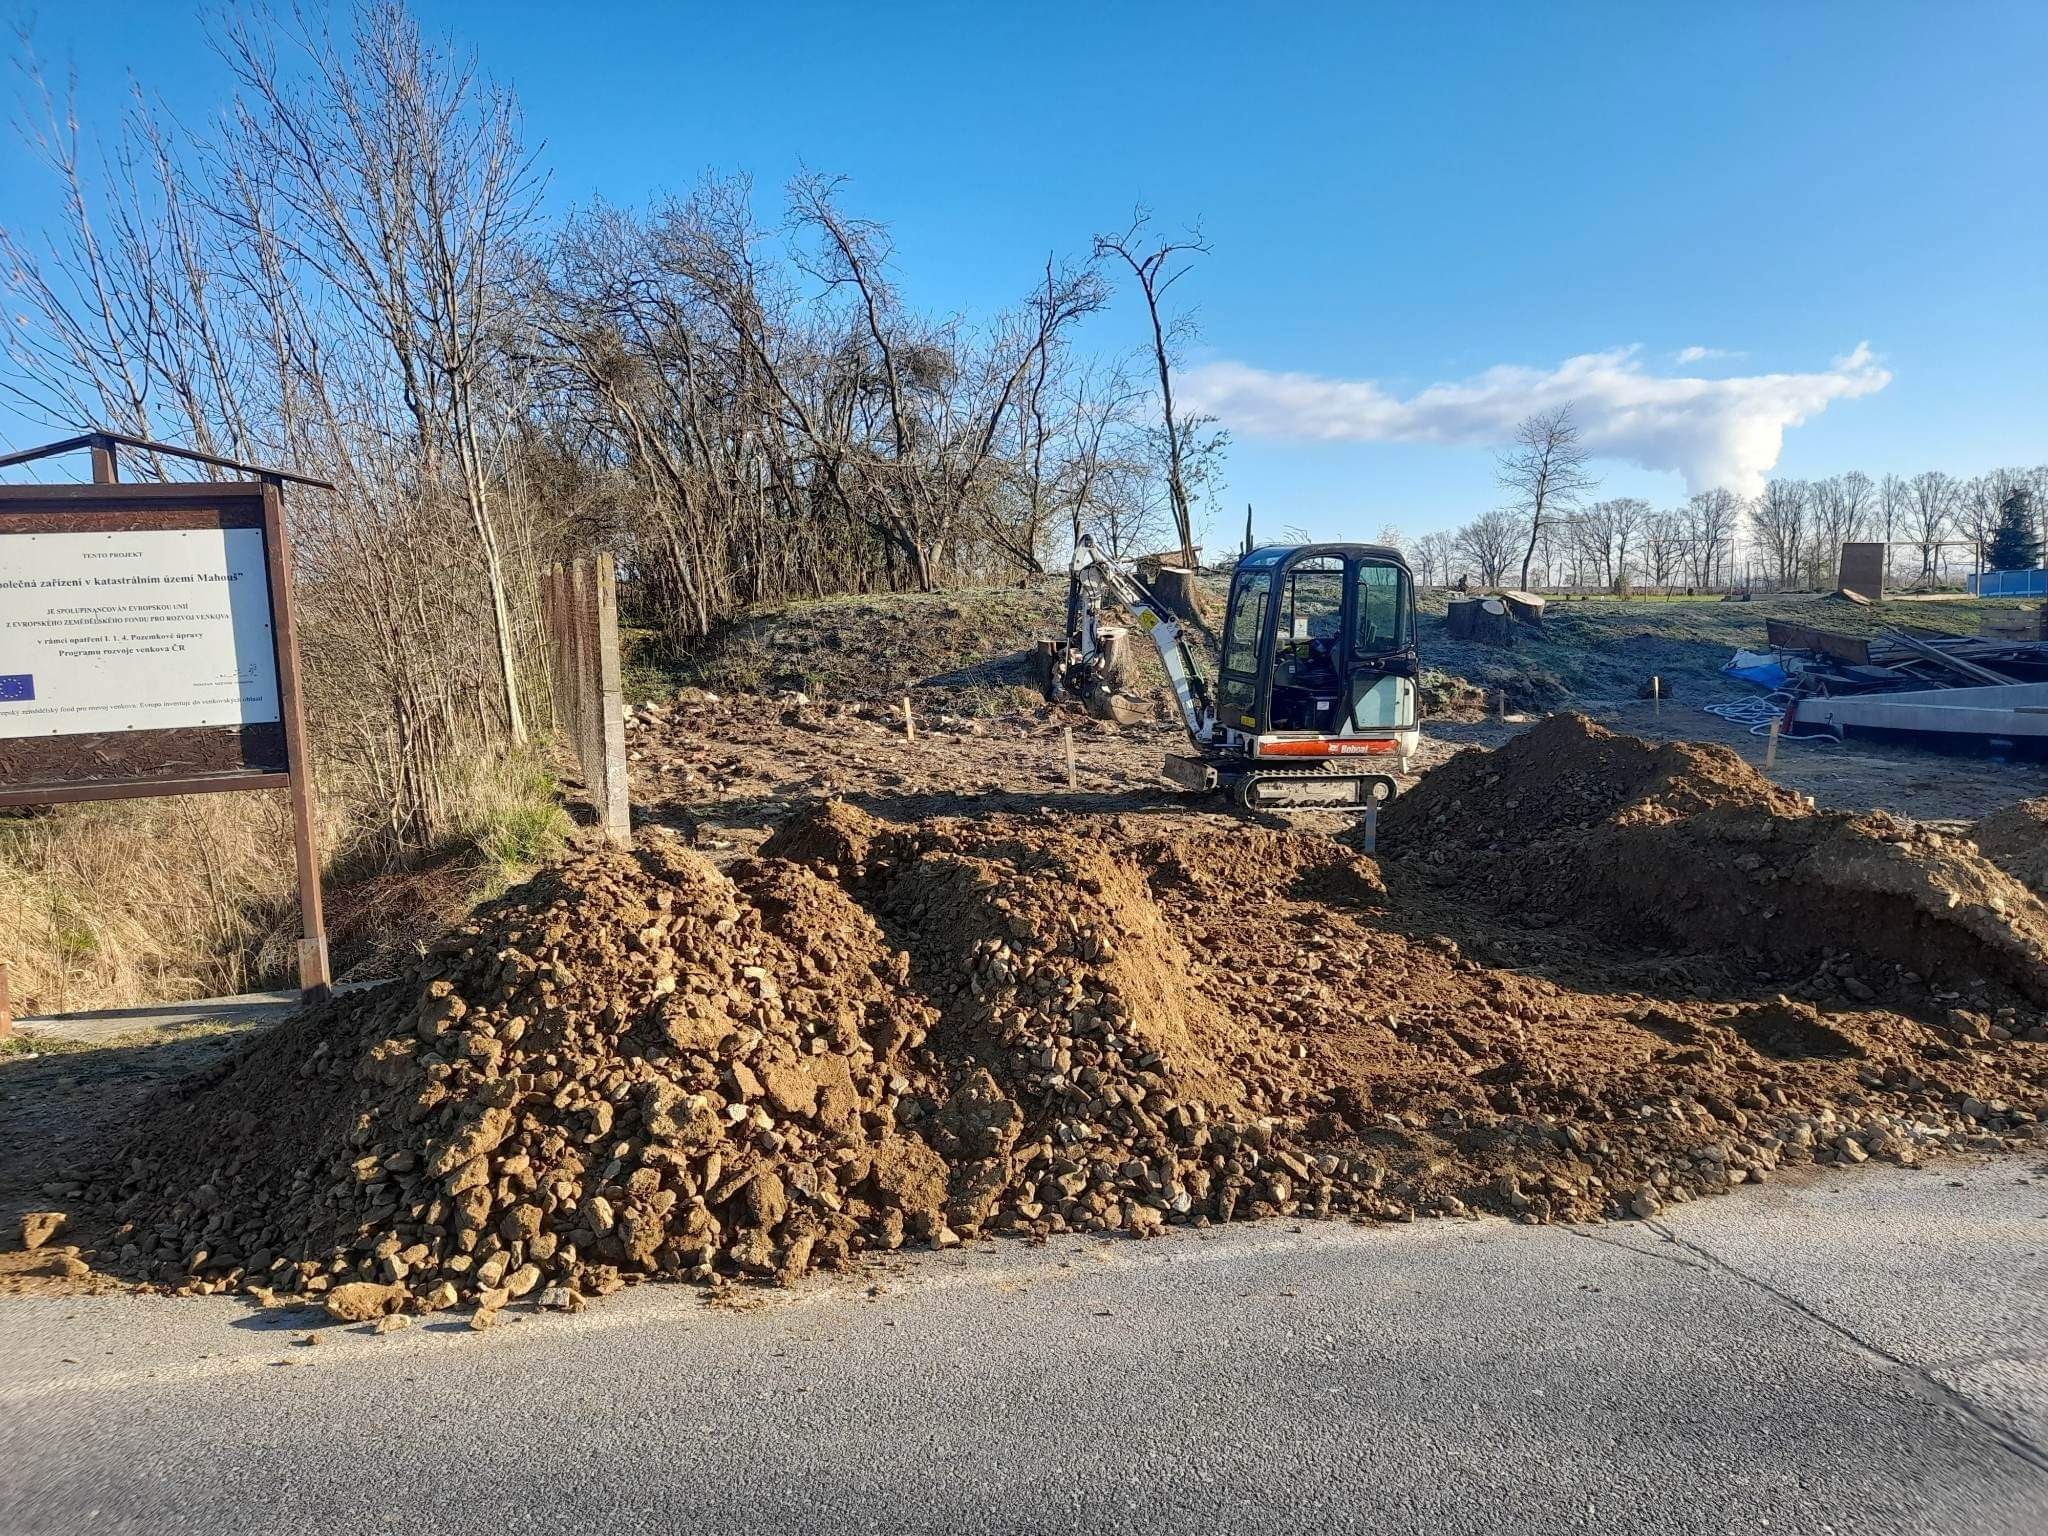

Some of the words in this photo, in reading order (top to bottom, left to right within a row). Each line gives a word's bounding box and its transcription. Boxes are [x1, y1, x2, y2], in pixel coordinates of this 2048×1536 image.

[40, 578, 82, 588] zařízení
[94, 576, 160, 586] katastrálním
[163, 575, 194, 583] území
[44, 636, 68, 645] rámci
[58, 649, 101, 657] Programu
[103, 646, 134, 655] rozvoje
[135, 644, 170, 653] venkova
[171, 643, 186, 652] ČR
[1341, 744, 1369, 754] Bobcat
